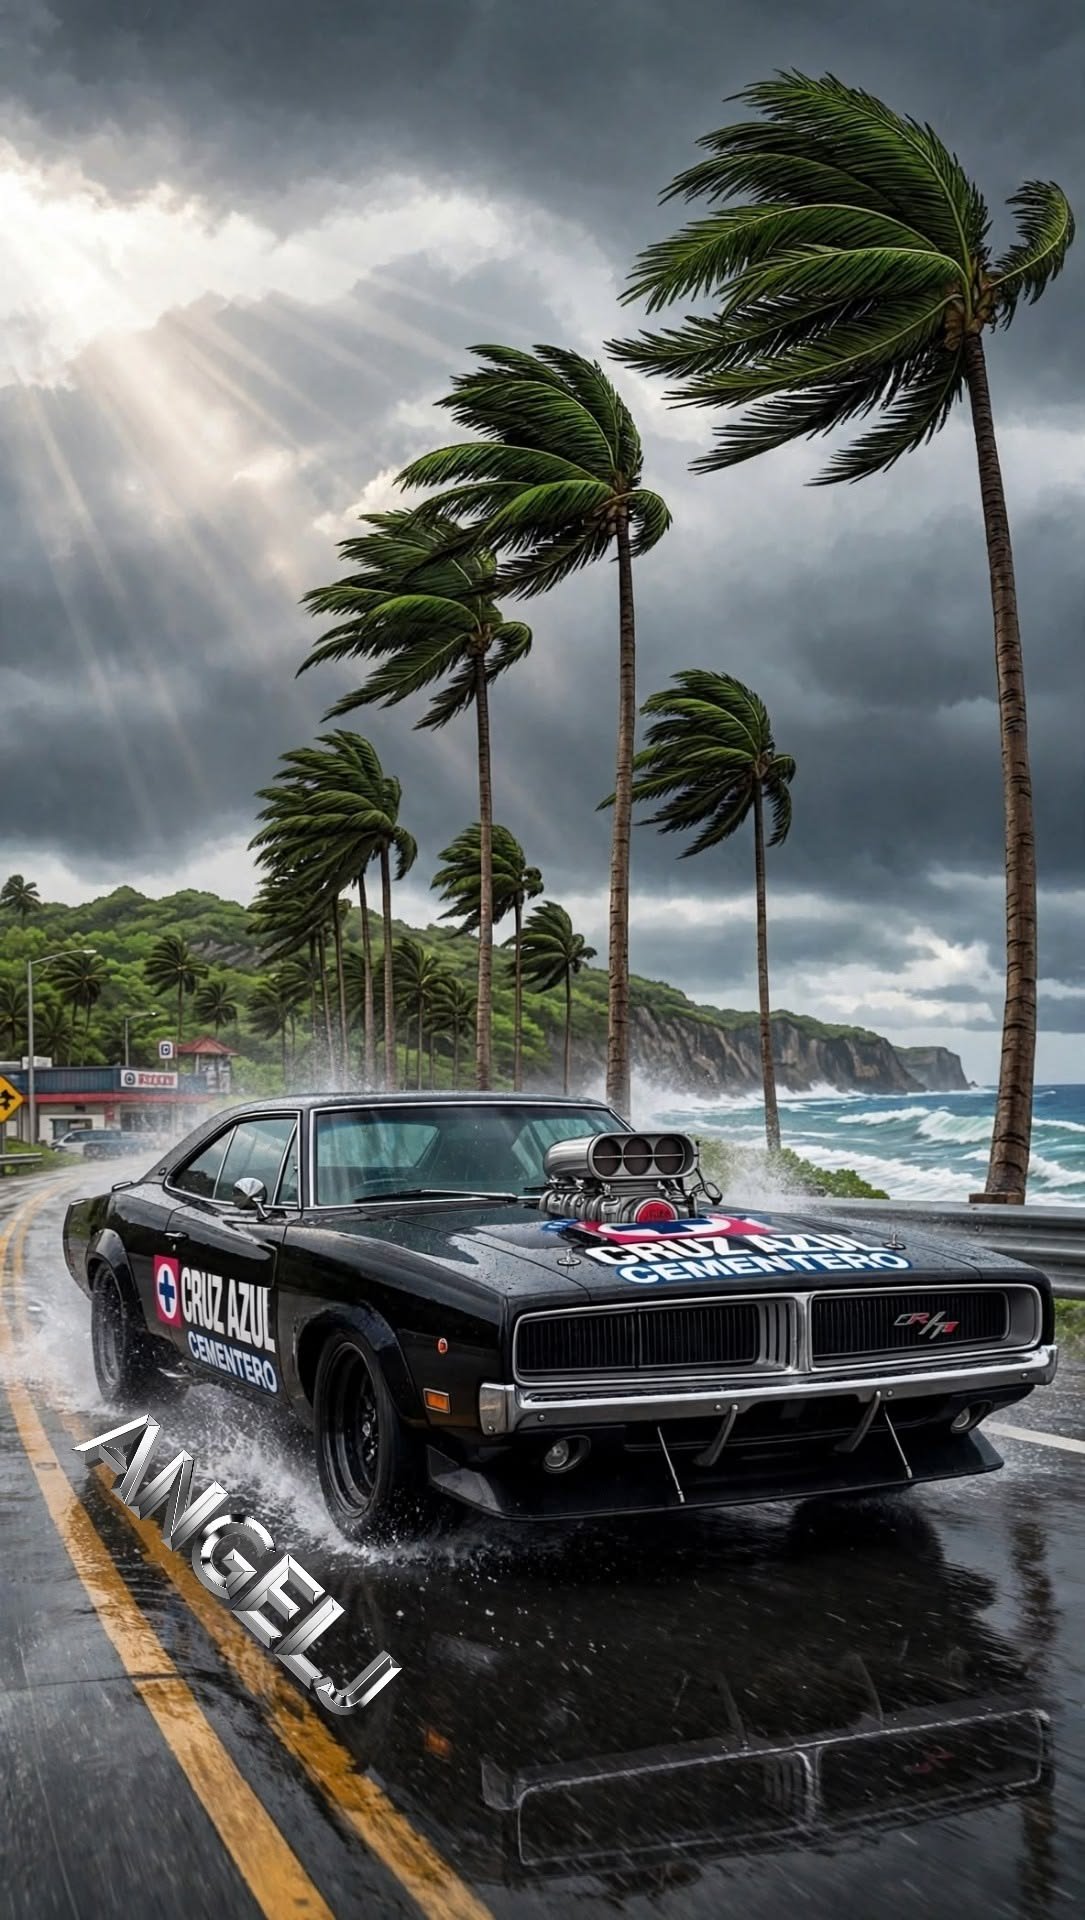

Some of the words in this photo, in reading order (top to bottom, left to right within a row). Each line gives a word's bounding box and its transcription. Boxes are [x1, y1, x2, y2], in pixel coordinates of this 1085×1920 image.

[585, 1236, 753, 1265] CRUZ
[743, 1233, 896, 1253] AZUL
[620, 1252, 910, 1283] CEMENTERO
[181, 1267, 225, 1335] CRUZ
[227, 1278, 276, 1353] AZUL
[188, 1331, 278, 1393] CEMENTERO
